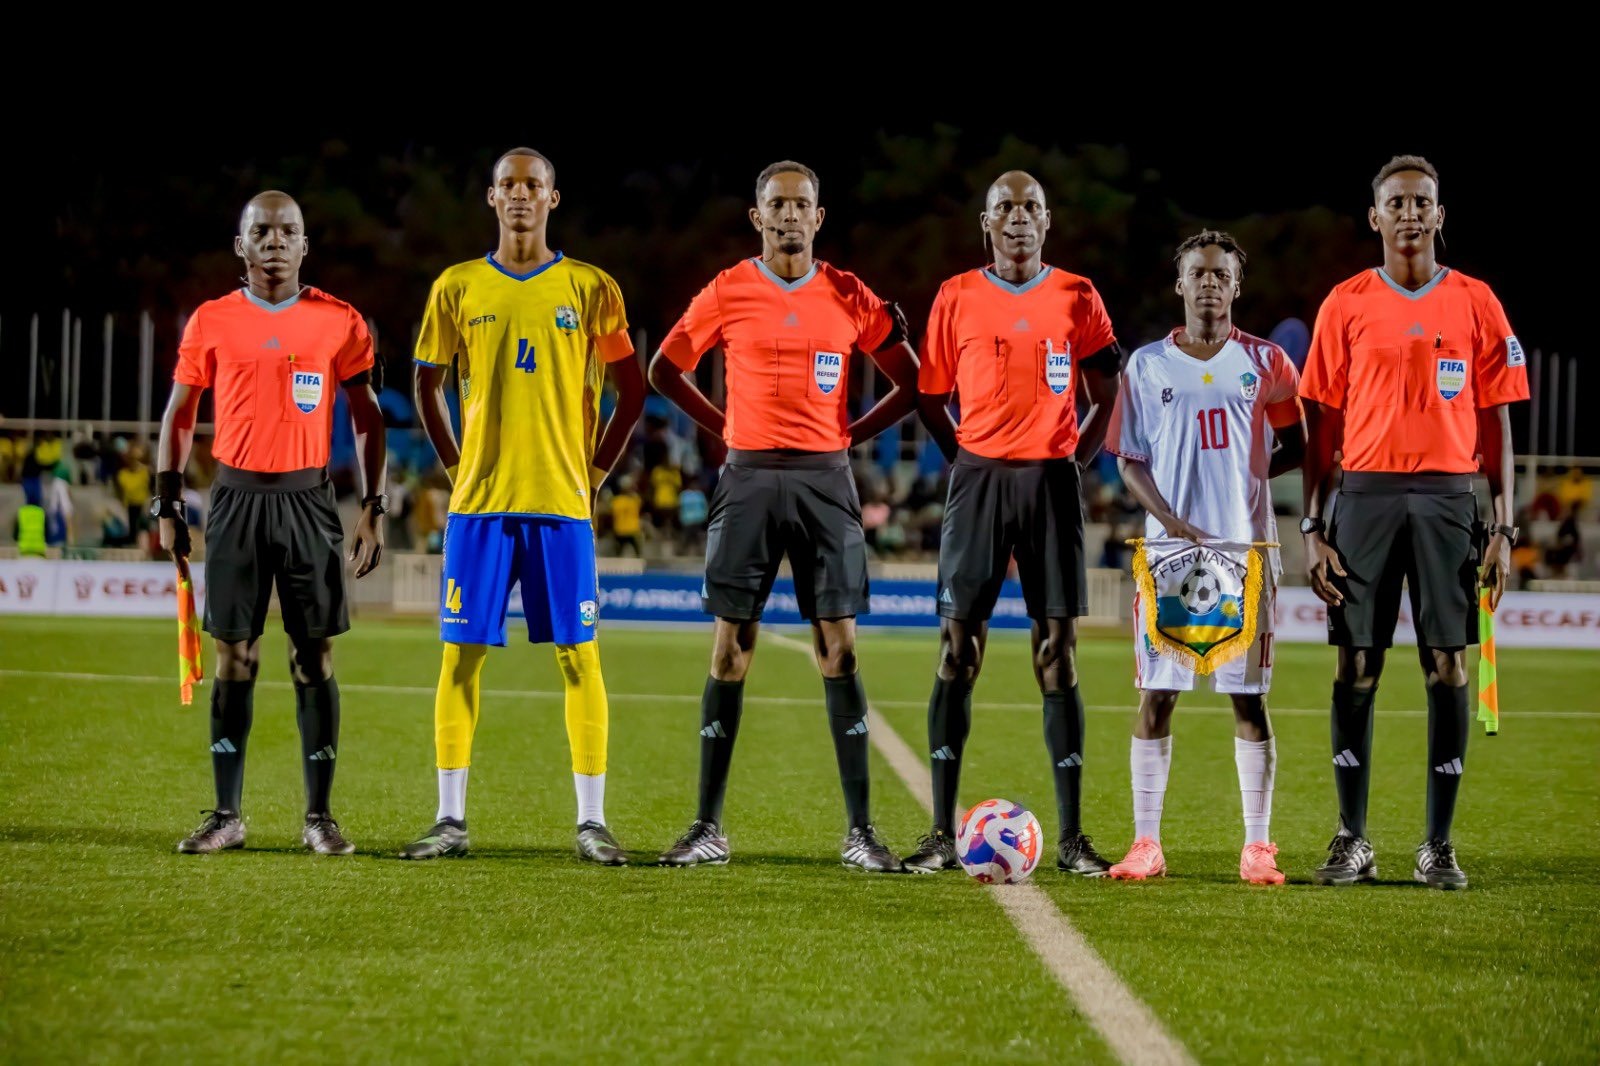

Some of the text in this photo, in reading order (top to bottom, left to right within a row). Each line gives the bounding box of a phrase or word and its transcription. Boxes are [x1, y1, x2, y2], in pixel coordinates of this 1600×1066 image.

[515, 338, 537, 374] 4
[817, 354, 840, 366] FIFA
[1049, 356, 1071, 366] FIFA
[1440, 361, 1464, 373] FIFA
[295, 374, 320, 386] FIFA
[1196, 407, 1230, 451] 10
[445, 578, 462, 614] 4
[1501, 607, 1600, 628] CECAF
[1258, 632, 1274, 668] 10
